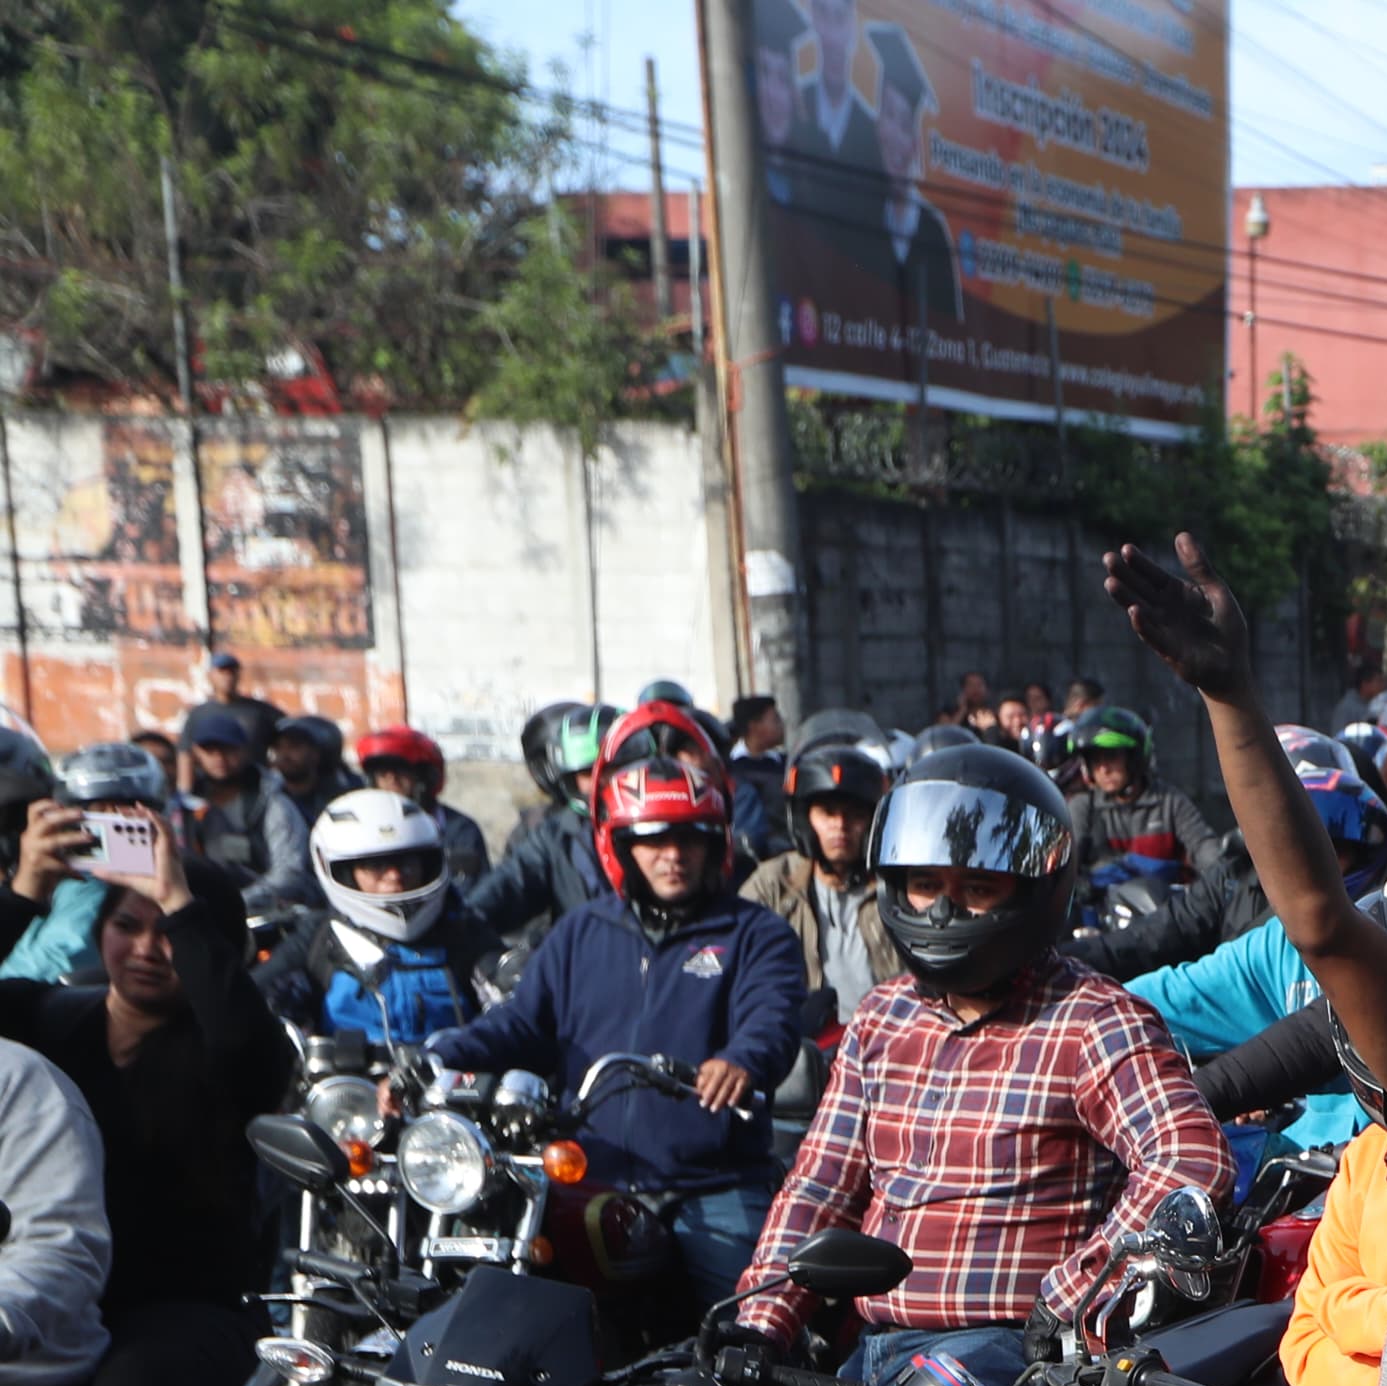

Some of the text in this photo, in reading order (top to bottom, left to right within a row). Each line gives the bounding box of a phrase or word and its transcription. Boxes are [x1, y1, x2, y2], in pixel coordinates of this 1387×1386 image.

[971, 59, 1095, 150] Inscripción
[822, 312, 842, 344] 12
[845, 318, 886, 350] calle
[445, 1359, 505, 1381] HONDA
